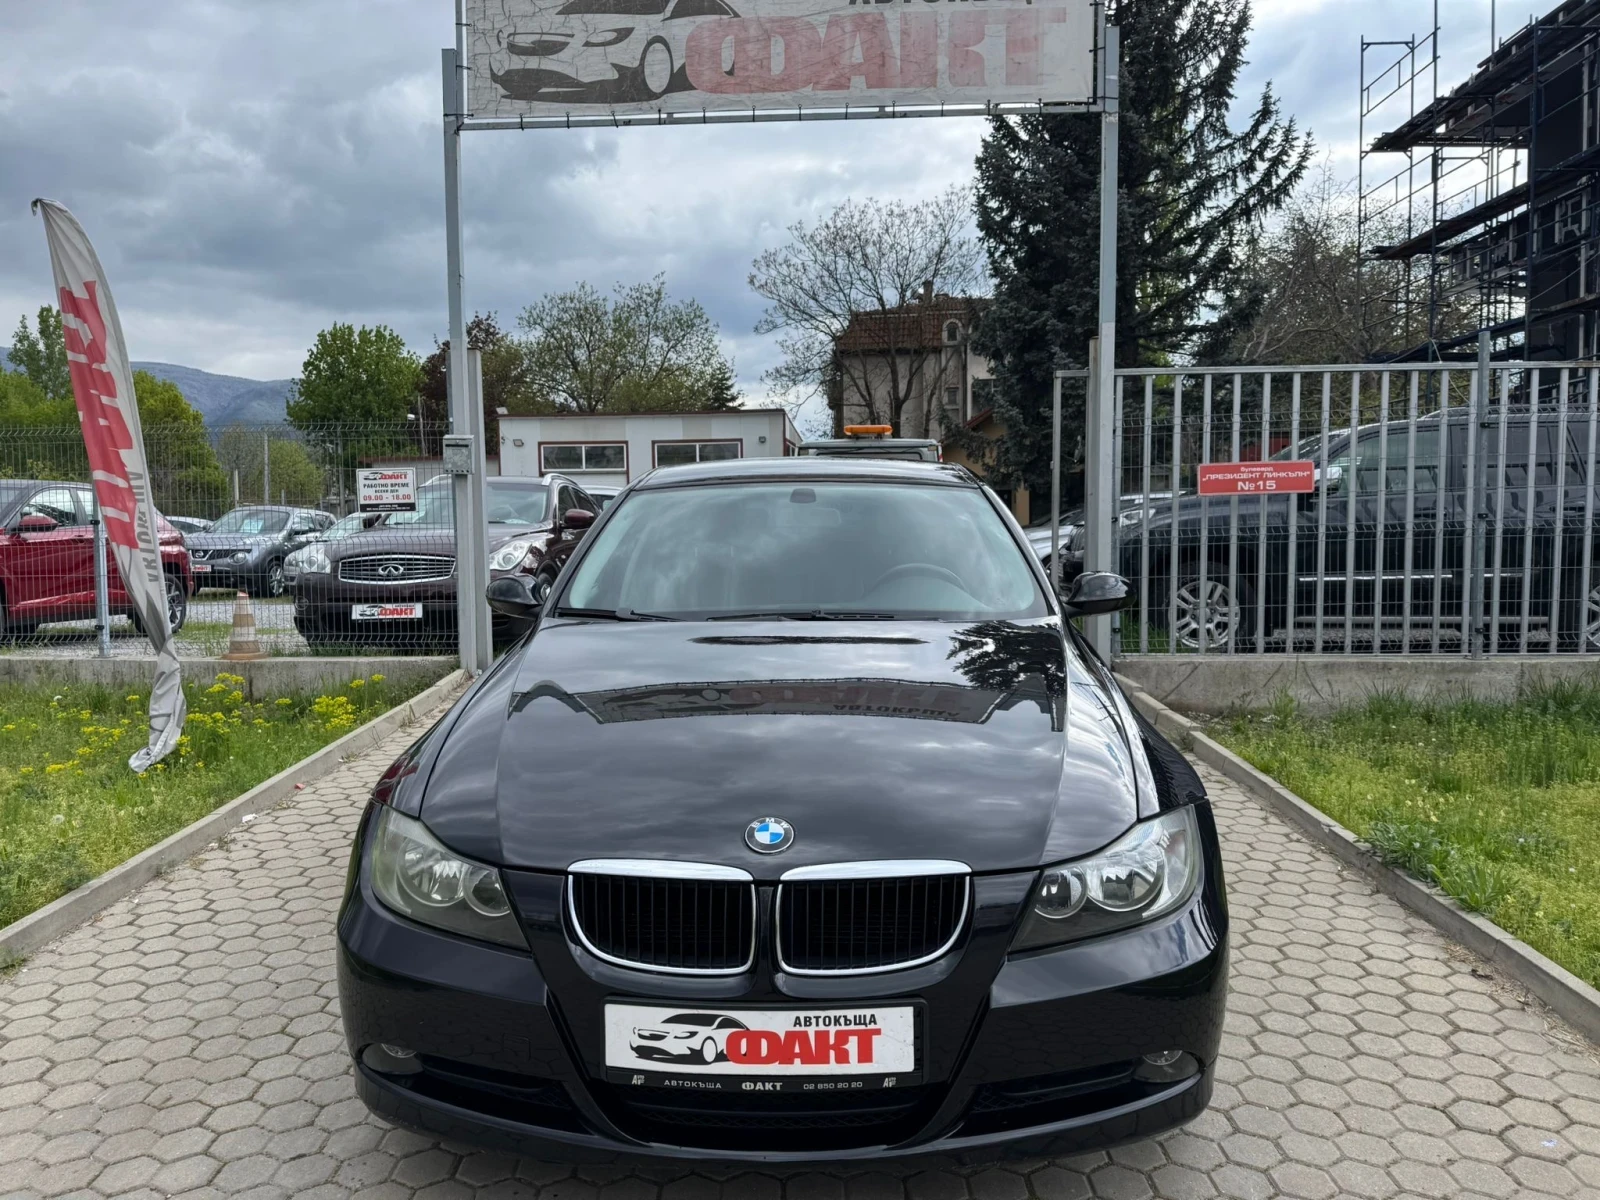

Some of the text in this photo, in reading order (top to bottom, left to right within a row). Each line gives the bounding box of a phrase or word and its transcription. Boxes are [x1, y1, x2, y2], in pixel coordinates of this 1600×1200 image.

[685, 6, 1067, 95] ФАКТ
[392, 493, 411, 501] 18.00
[750, 817, 791, 829] BMW
[793, 1013, 878, 1028] АВТОКЪЩА
[725, 1028, 882, 1065] ФАКТ
[741, 1081, 783, 1091] ФАКТ
[817, 1082, 835, 1090] 850
